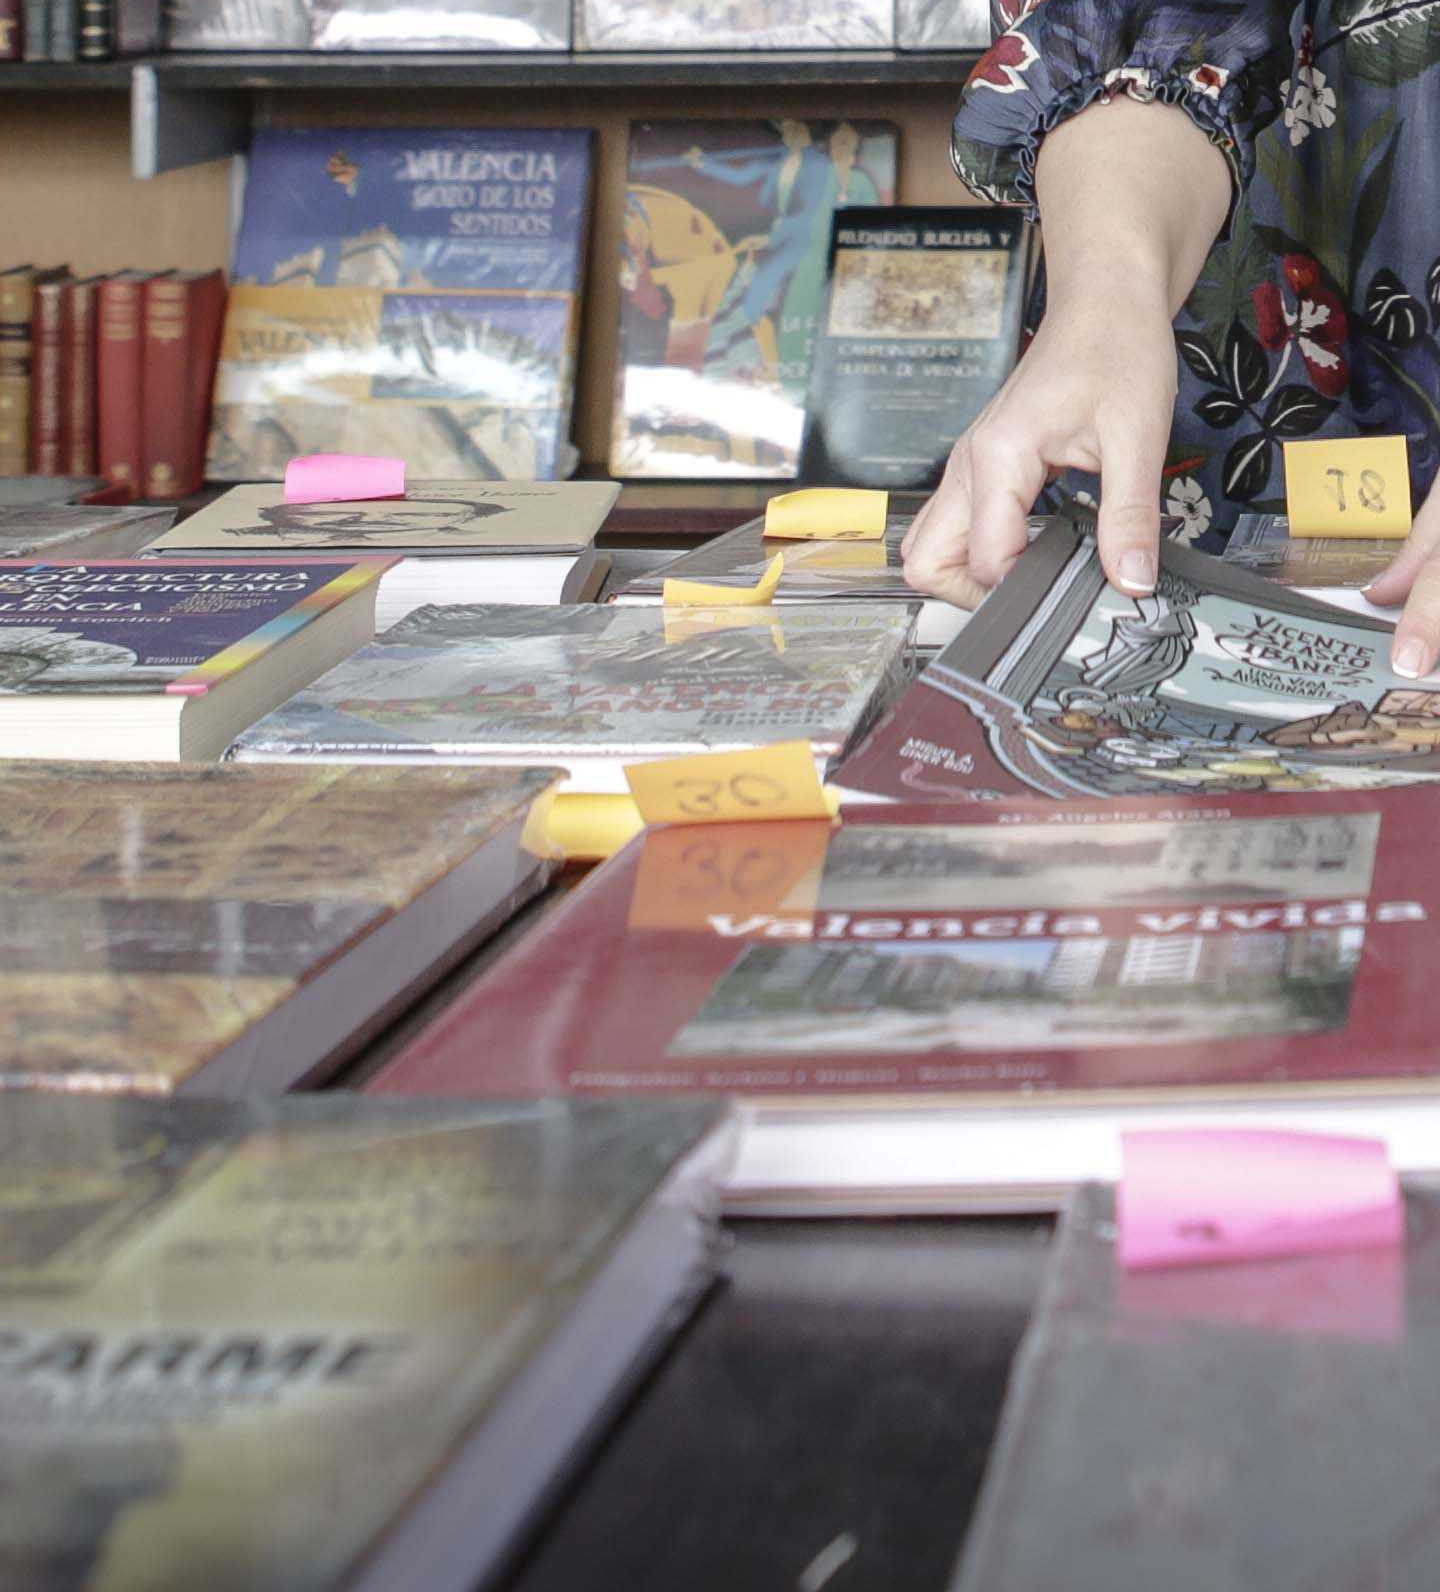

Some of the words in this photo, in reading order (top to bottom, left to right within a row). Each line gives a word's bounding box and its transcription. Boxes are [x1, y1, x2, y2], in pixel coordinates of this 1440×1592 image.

[402, 149, 558, 182] VALENCIA
[479, 184, 511, 208] DE
[514, 183, 556, 208] LOS
[449, 212, 553, 237] SENTIDOS
[23, 592, 81, 604] EN
[1245, 624, 1372, 670] BLASCO
[1253, 611, 1375, 658] VICENTE
[898, 746, 942, 768] GINER
[905, 736, 958, 760] MIGUEL
[673, 770, 788, 816] 30
[704, 910, 1102, 941] Valencia
[1136, 898, 1432, 935] vivida
